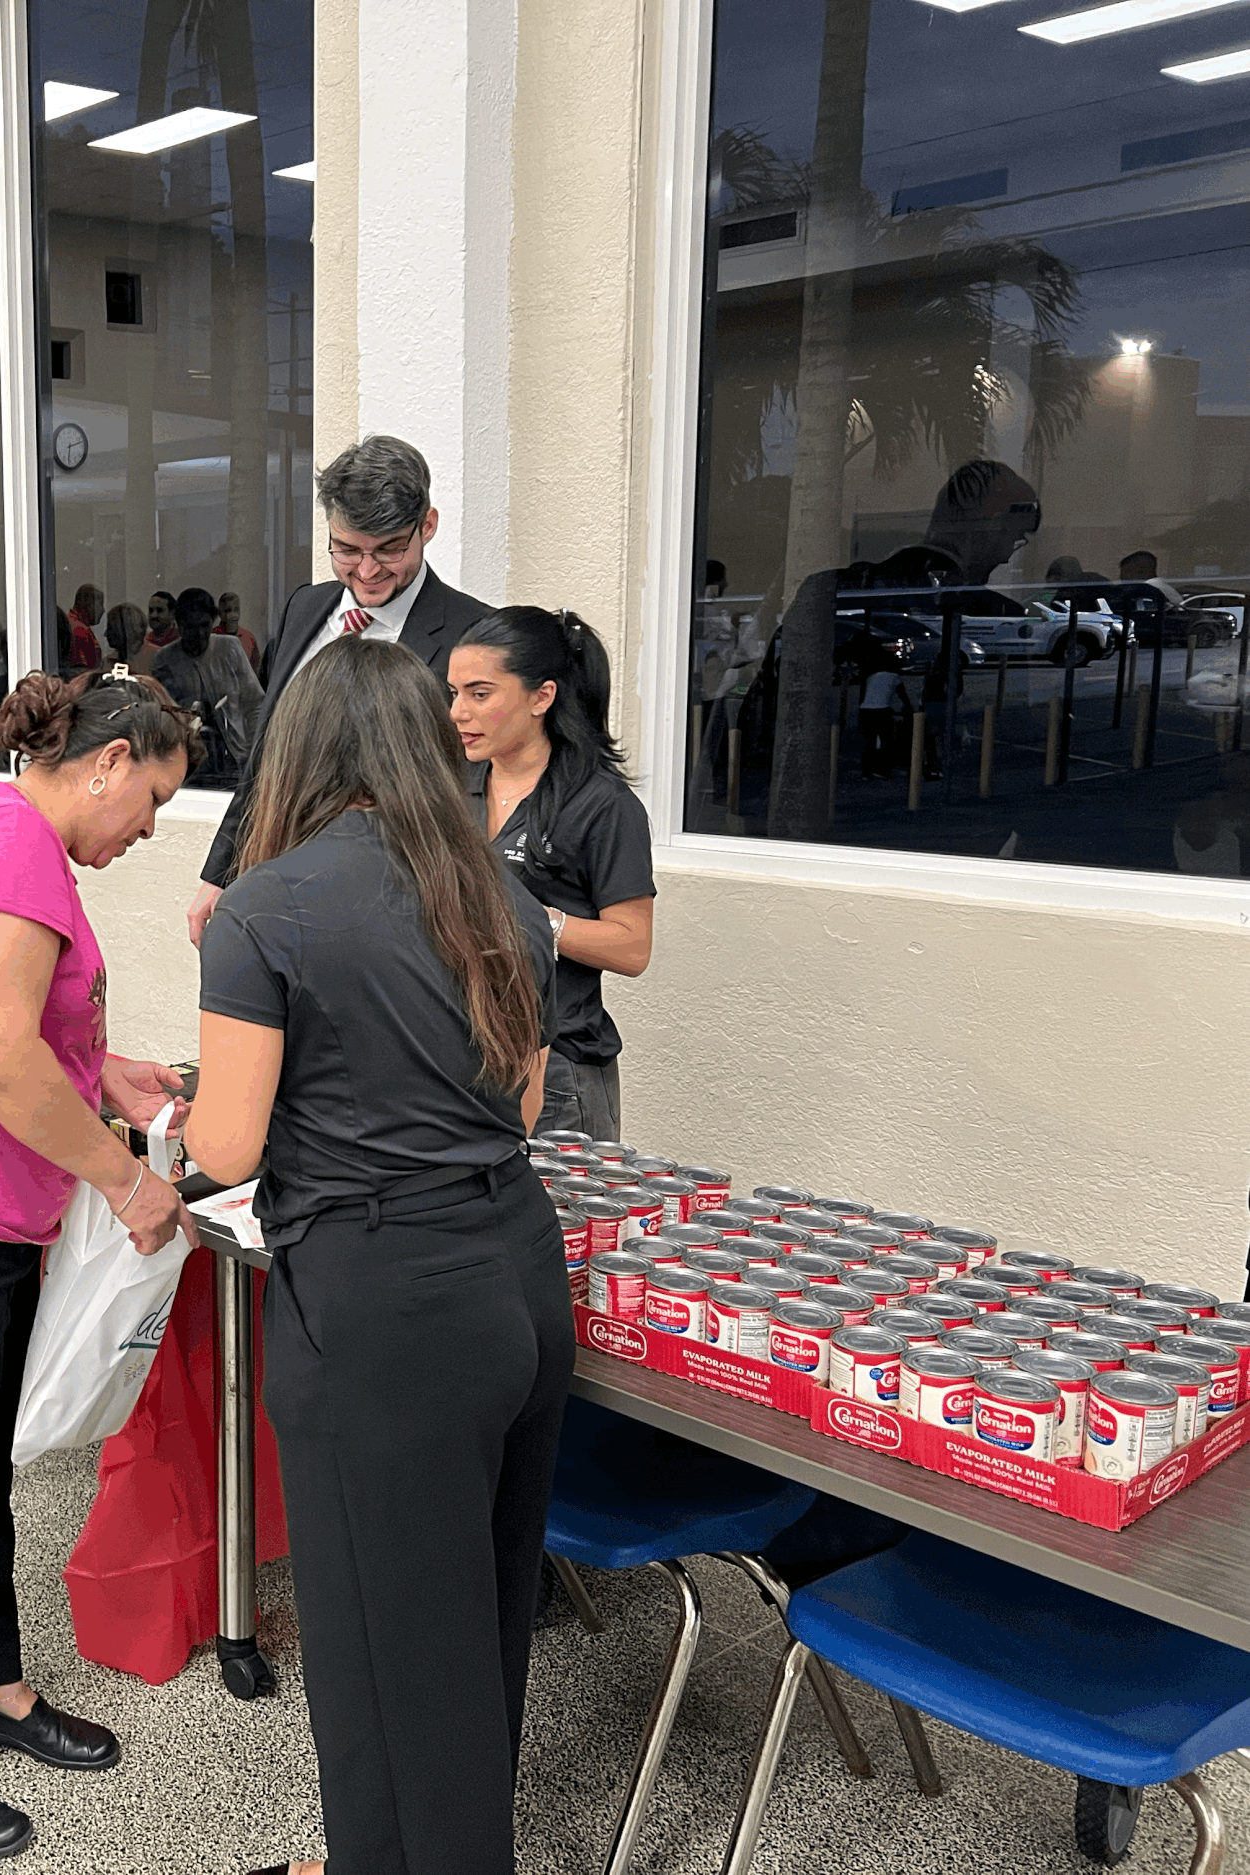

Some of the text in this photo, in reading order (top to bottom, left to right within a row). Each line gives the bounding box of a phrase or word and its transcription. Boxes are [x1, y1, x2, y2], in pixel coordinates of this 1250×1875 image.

[647, 1299, 688, 1319] Carnation
[592, 1324, 643, 1350] Carnation
[772, 1335, 817, 1358] Carnation
[682, 1349, 772, 1384] EVAPORATED MILK
[834, 1407, 896, 1438] Carnation
[978, 1408, 1032, 1434] Carnation
[945, 1441, 1056, 1486] EVAPORATED MILK
[992, 1467, 1015, 1480] 100%
